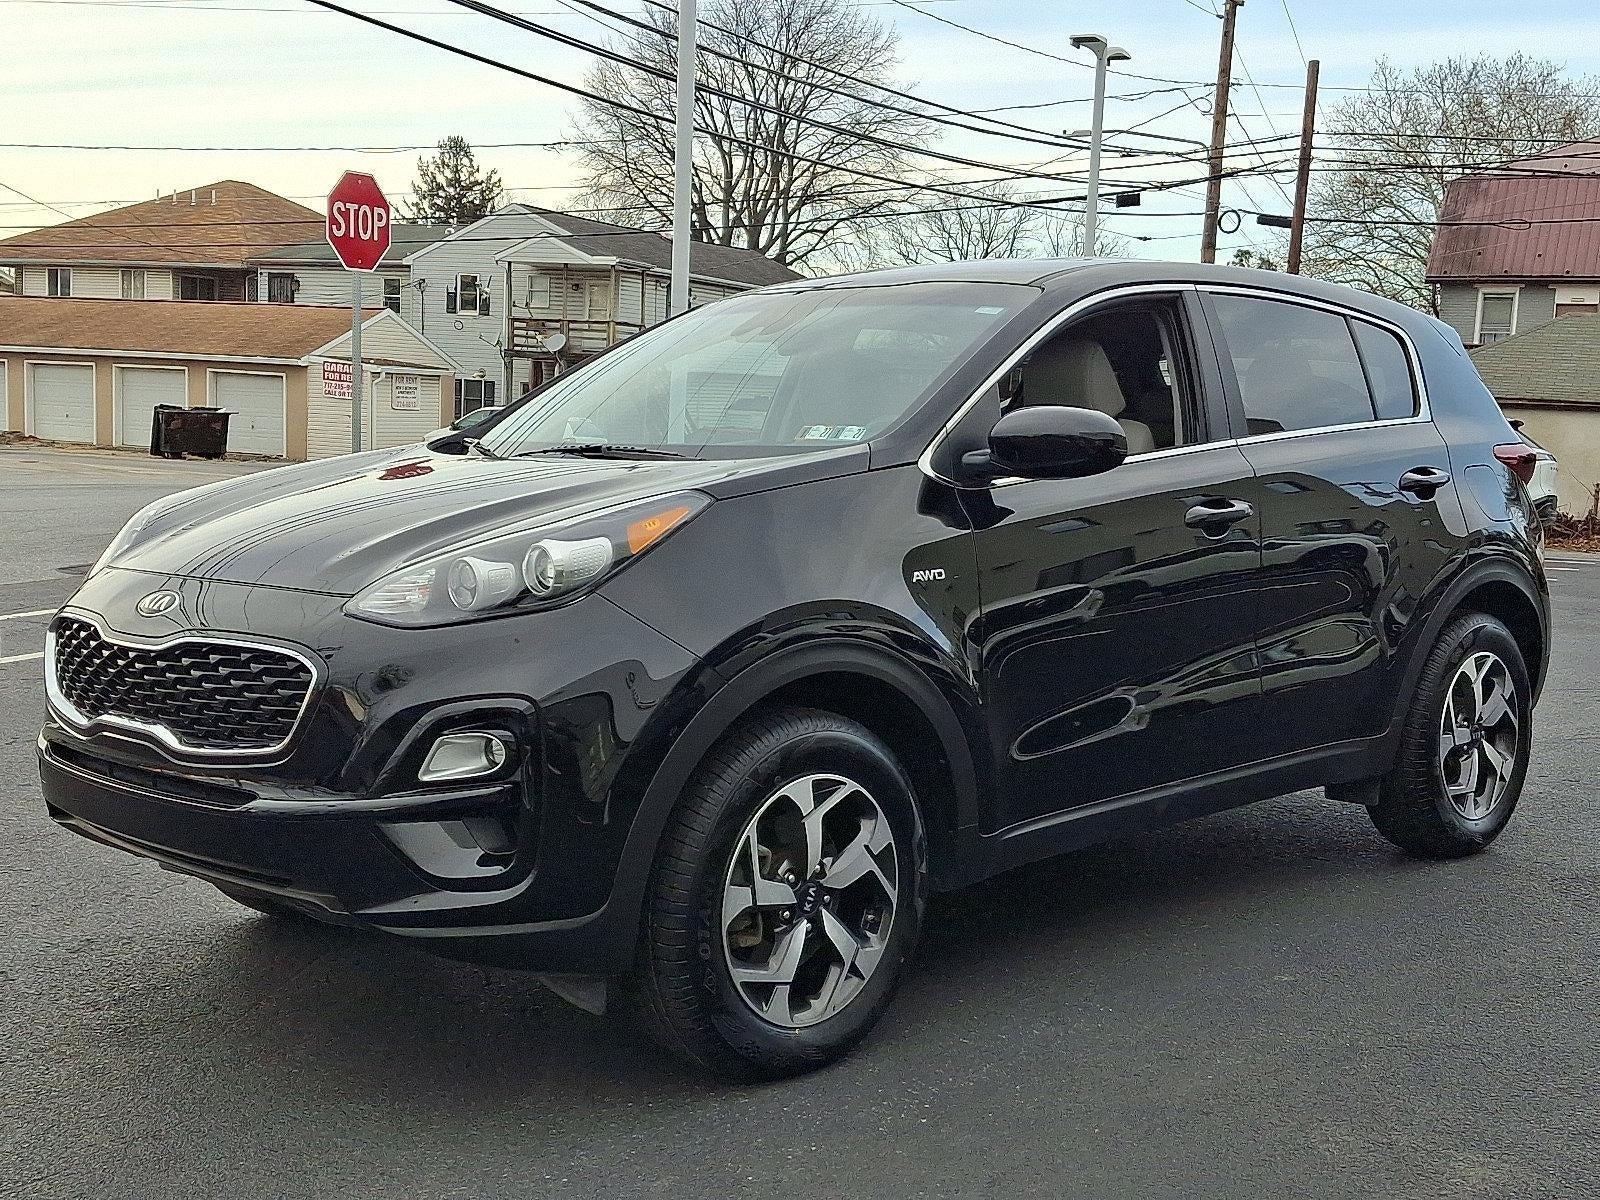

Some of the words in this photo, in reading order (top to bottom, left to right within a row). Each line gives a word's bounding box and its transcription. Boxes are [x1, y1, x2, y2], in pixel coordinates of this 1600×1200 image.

[332, 201, 387, 241] STOP
[324, 371, 340, 381] FOR
[340, 374, 353, 382] RE
[912, 568, 946, 583] AWD
[803, 886, 817, 911] KIA
